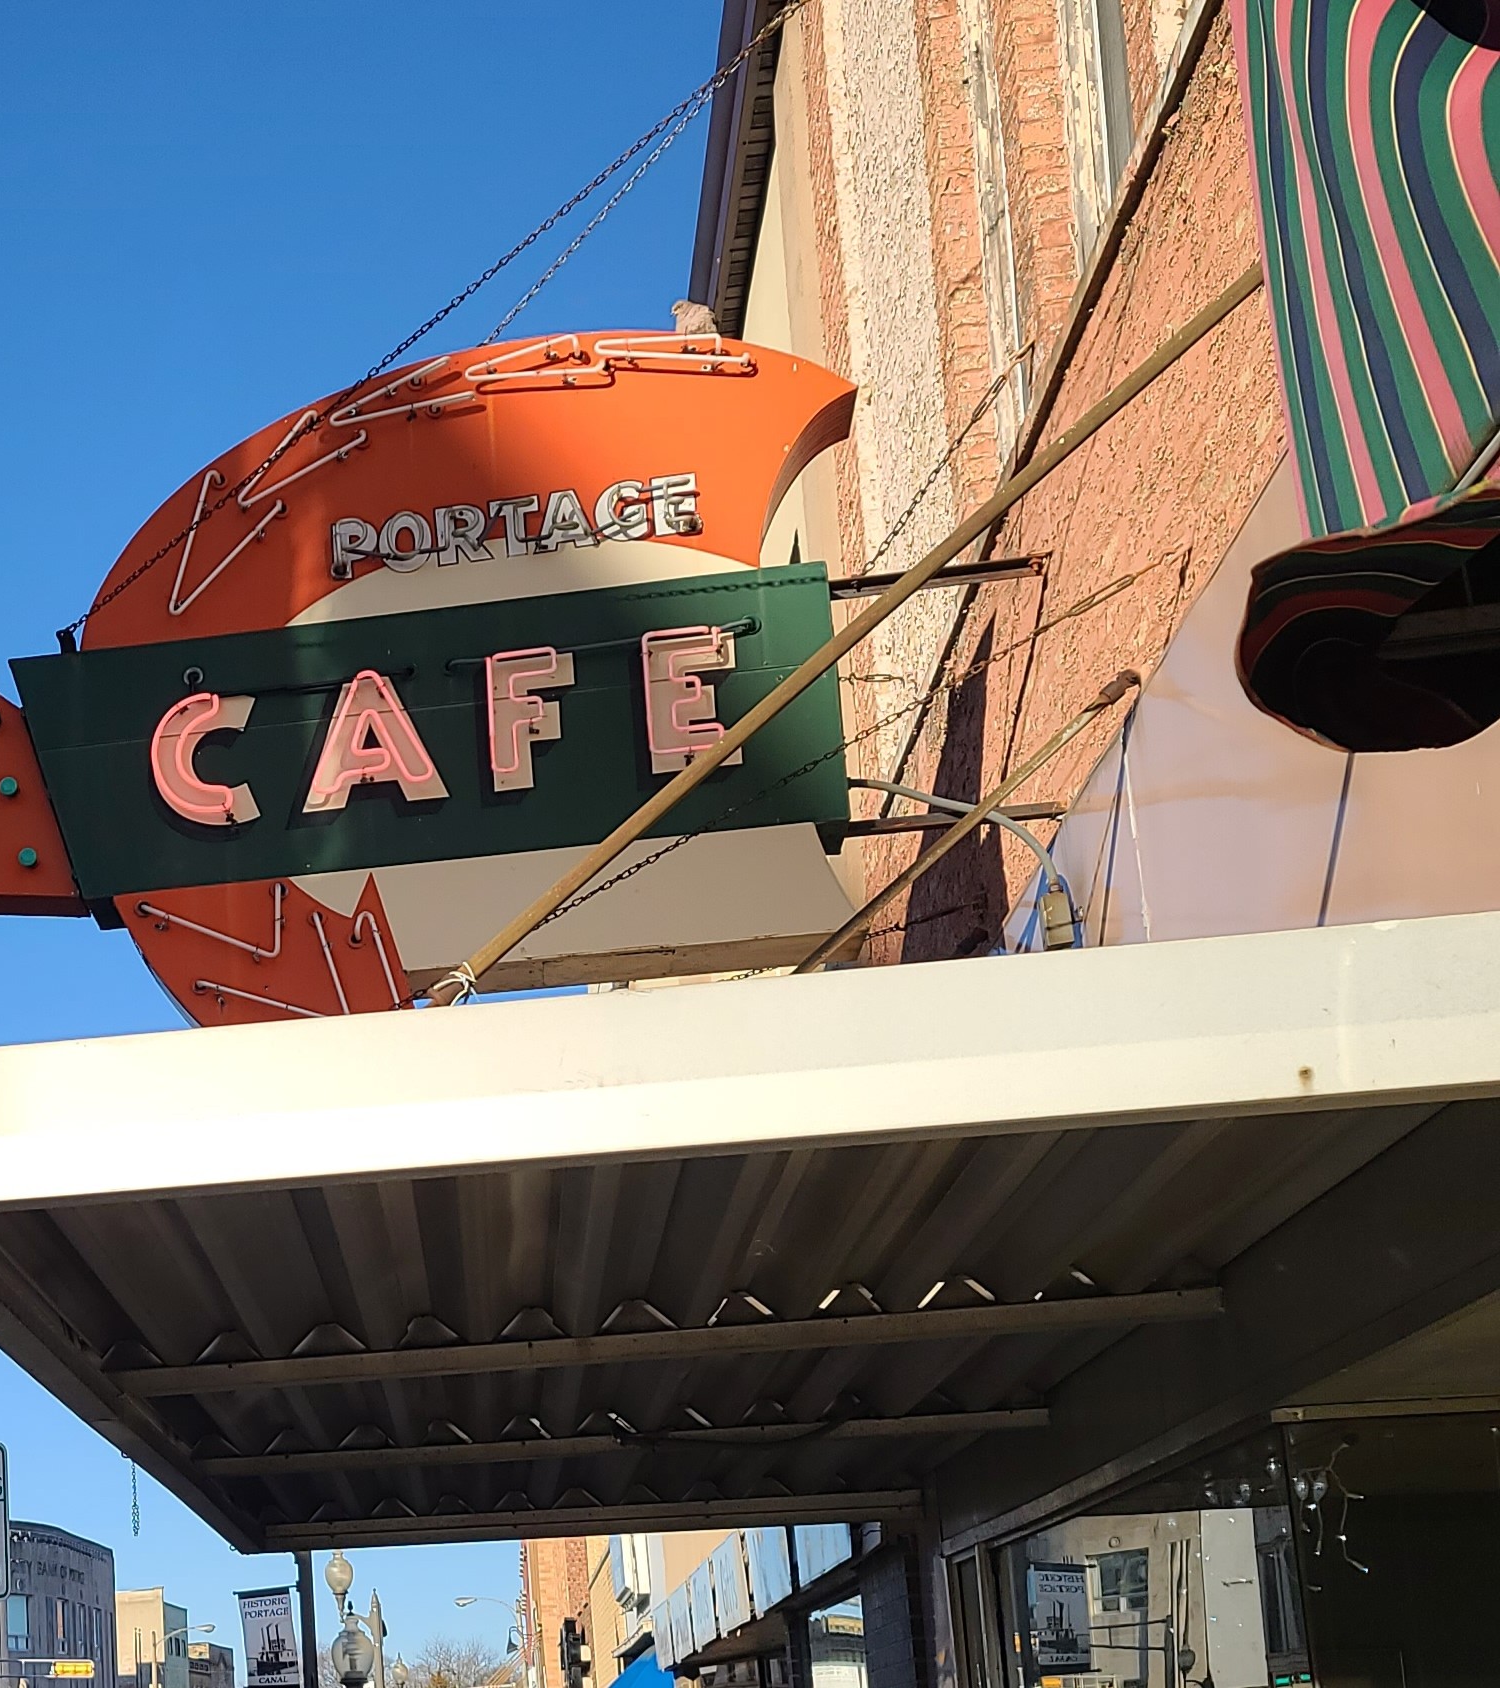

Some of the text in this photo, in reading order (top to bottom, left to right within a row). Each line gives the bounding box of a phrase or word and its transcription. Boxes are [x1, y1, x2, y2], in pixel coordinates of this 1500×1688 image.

[331, 473, 701, 579] PORTAGE
[150, 625, 744, 825] CAFE
[243, 1597, 288, 1609] HISTORIC
[244, 1607, 289, 1619] PORTAGE
[258, 1675, 288, 1684] CANAL
